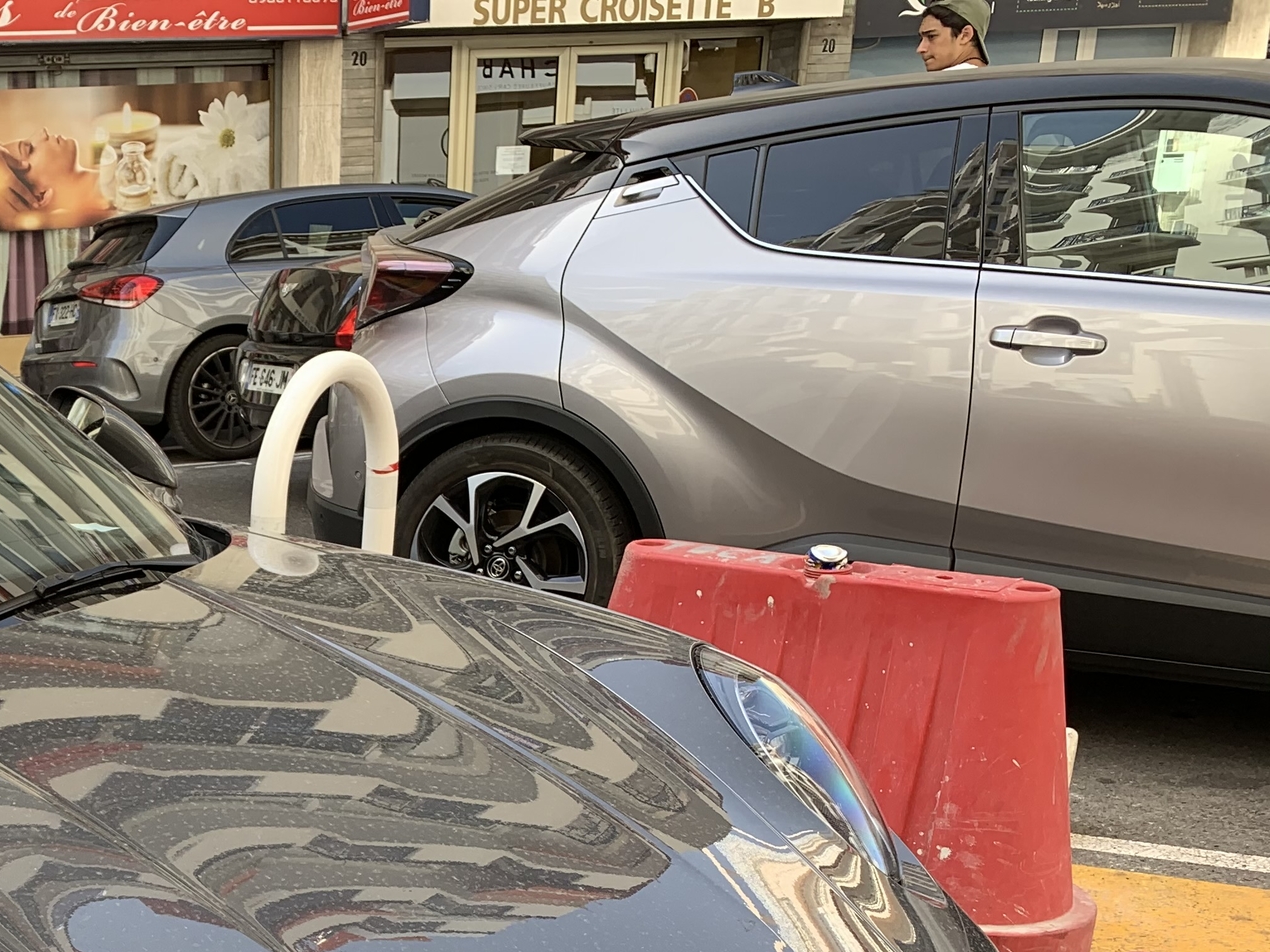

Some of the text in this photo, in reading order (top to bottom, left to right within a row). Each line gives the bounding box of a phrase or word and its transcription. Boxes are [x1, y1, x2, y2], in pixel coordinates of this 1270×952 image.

[53, 5, 247, 33] de Bien-être
[473, 0, 567, 26] SUPER
[821, 37, 836, 54] 20
[351, 50, 367, 67] 20
